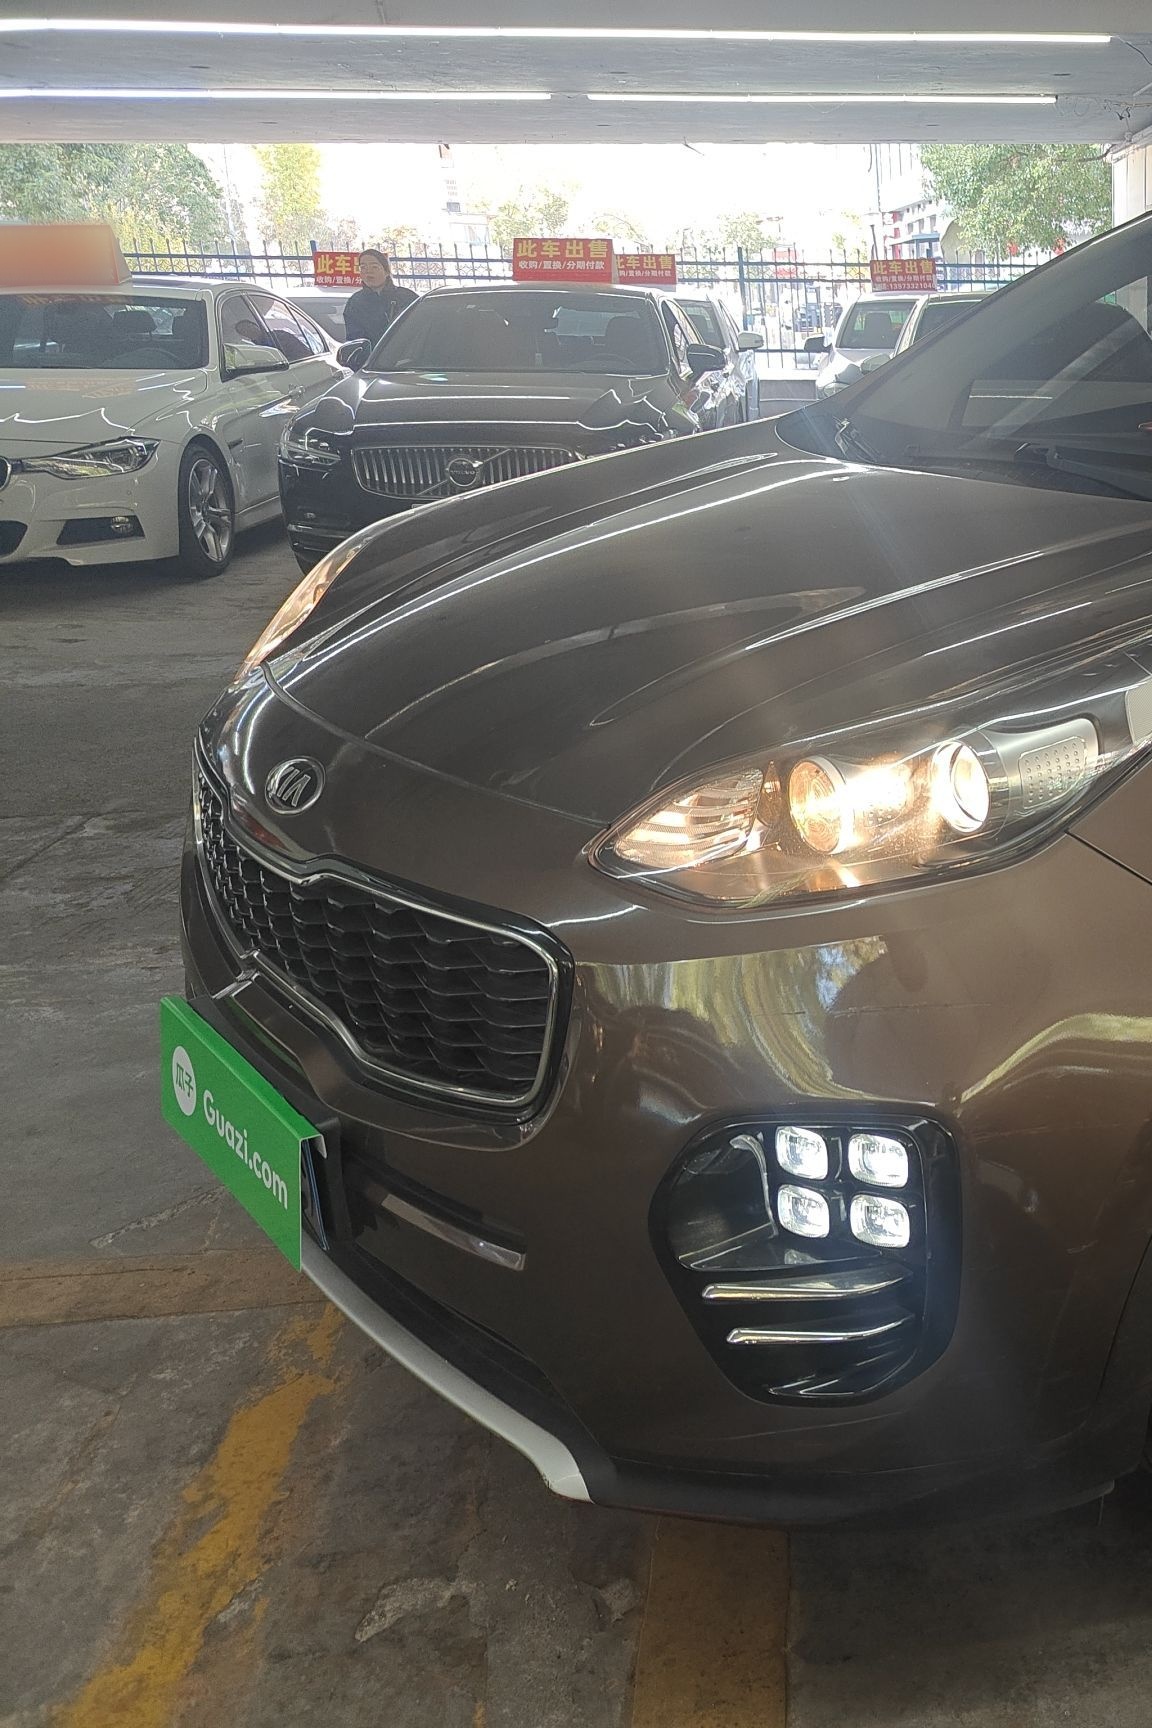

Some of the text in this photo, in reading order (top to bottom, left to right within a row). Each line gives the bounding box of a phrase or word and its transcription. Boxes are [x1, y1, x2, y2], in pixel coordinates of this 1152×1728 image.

[516, 240, 608, 258] 此车出售
[518, 260, 605, 270] 收购/置换/分期付款
[873, 260, 933, 275] 此车出售
[618, 270, 672, 278] 购/置换/分期付款
[175, 1062, 194, 1098] 瓜子
[203, 1089, 288, 1210] Guazi.com
